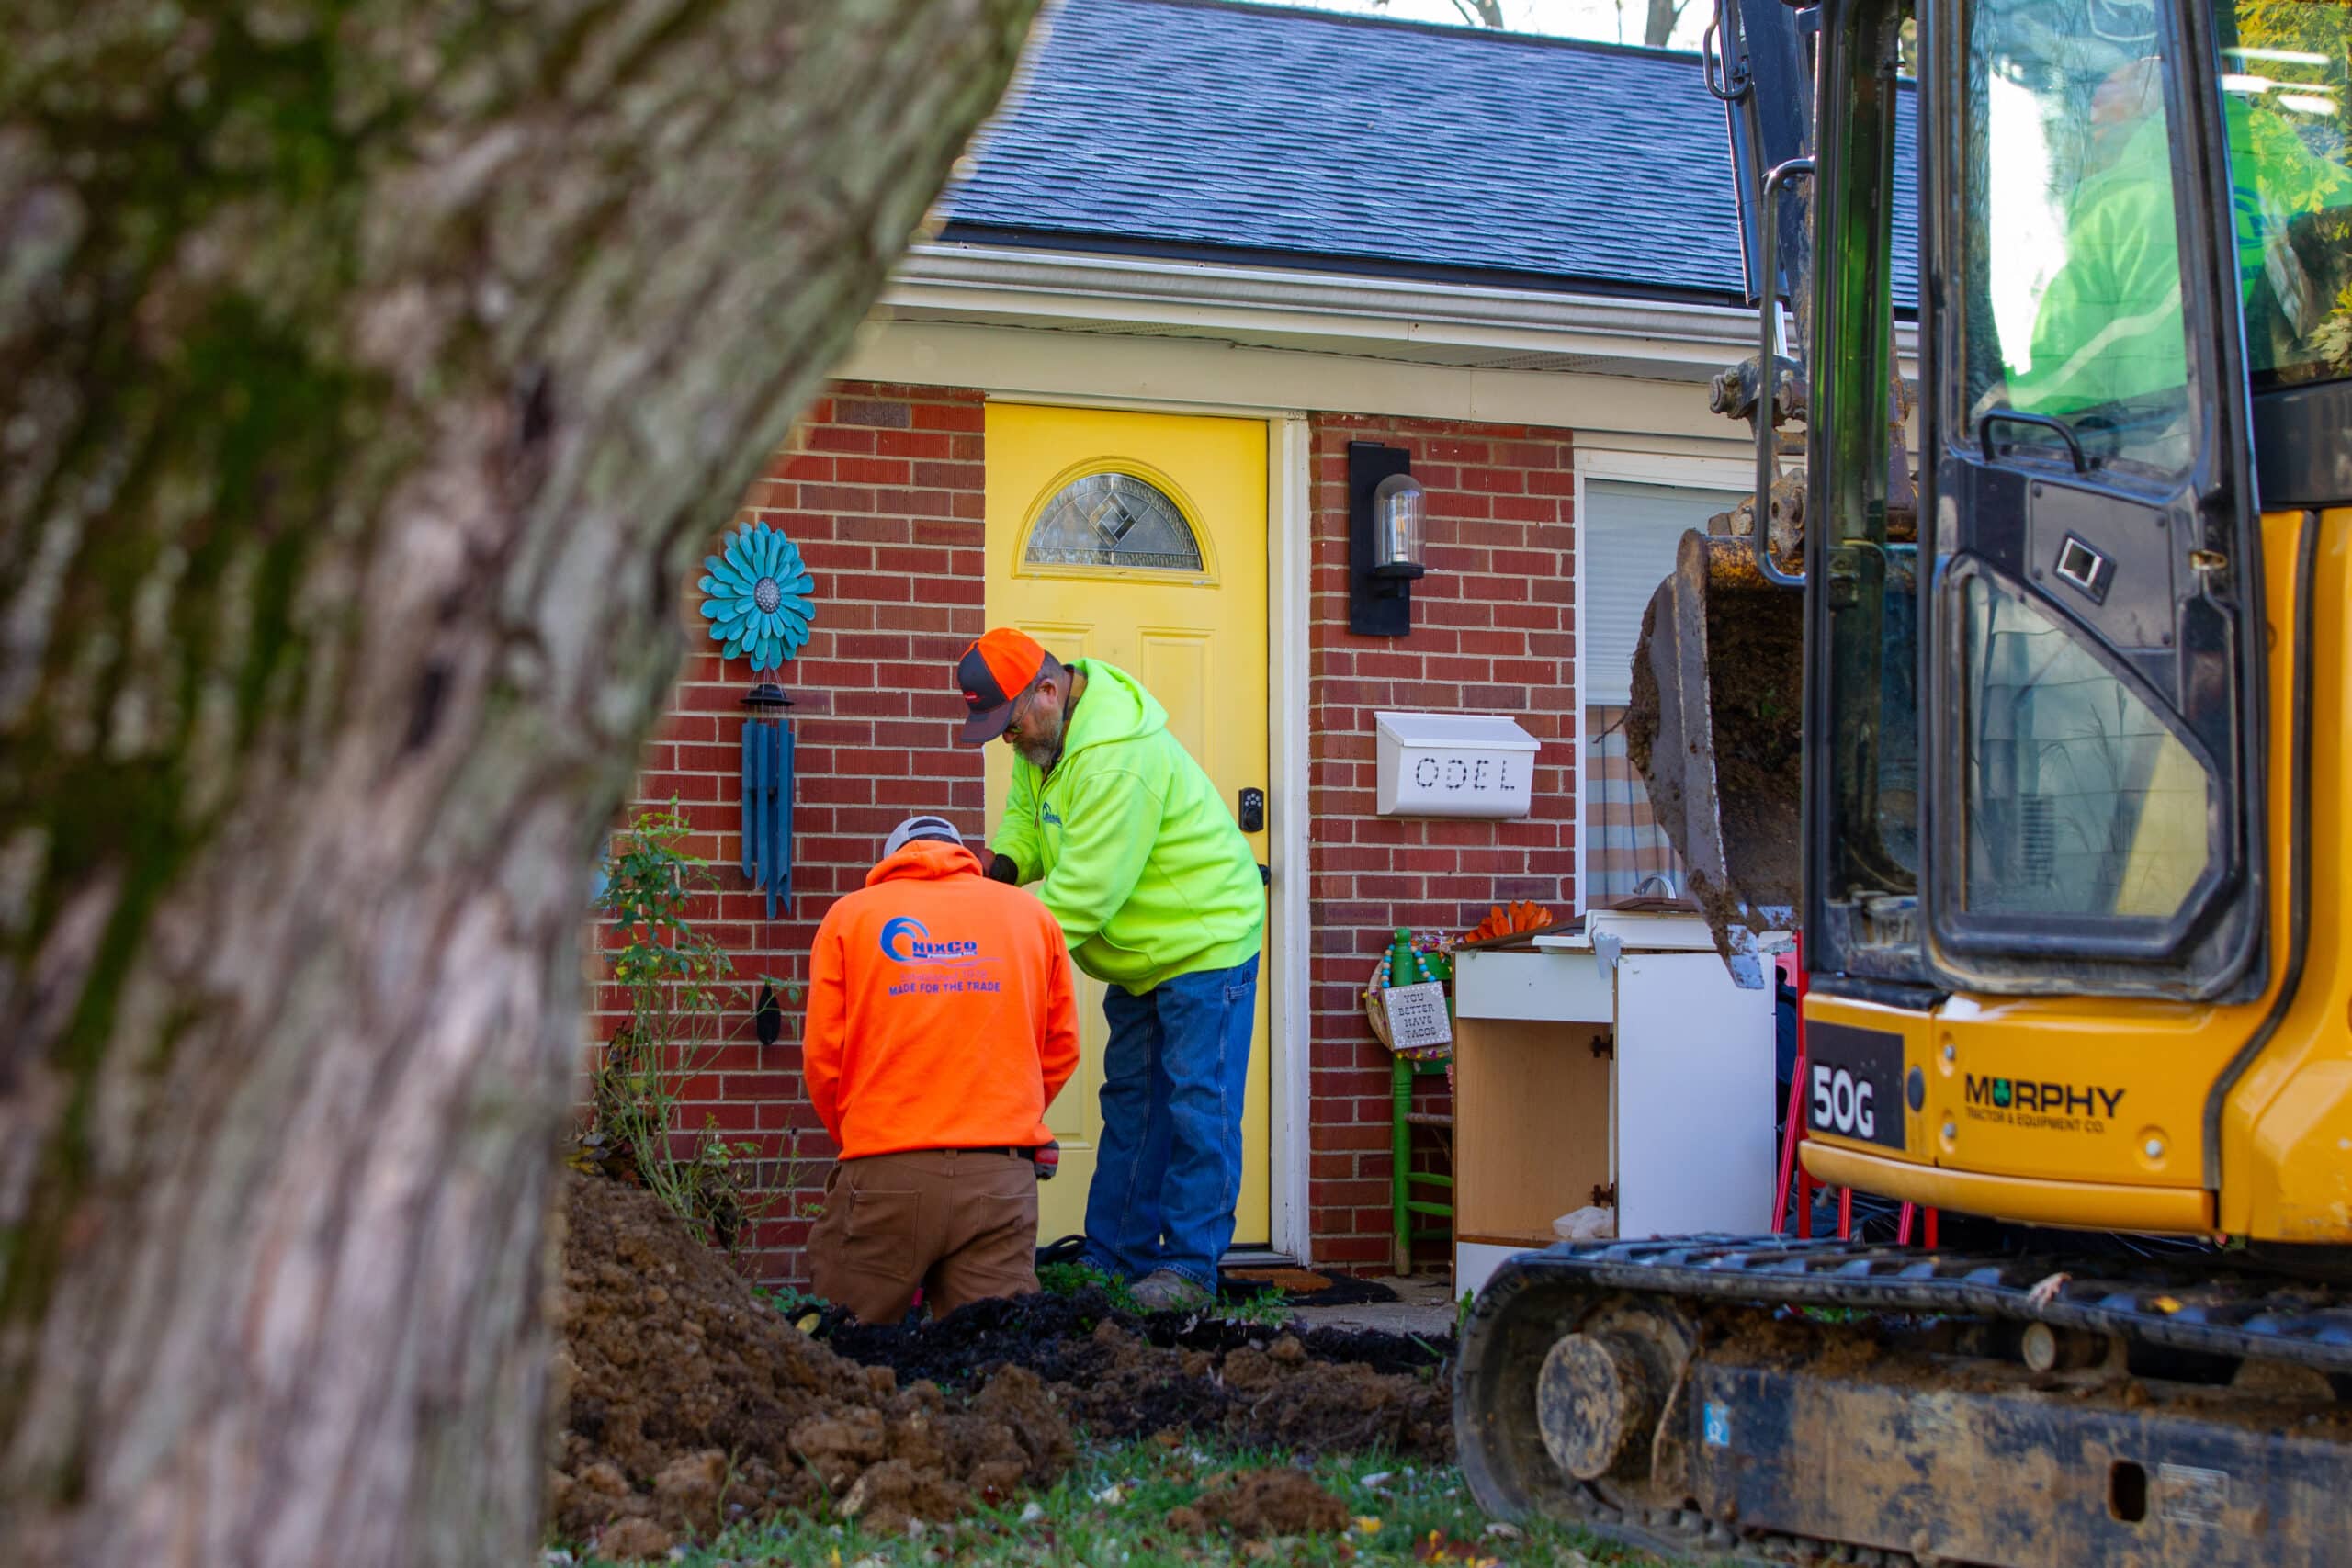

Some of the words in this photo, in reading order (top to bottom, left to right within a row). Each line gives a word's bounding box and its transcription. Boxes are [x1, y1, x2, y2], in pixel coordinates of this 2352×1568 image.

[1415, 758, 1515, 790] ODEL
[888, 982, 916, 996] MADE
[920, 982, 939, 993] FOR
[944, 981, 963, 992] THE
[967, 981, 1001, 992] TRADE
[1404, 993, 1424, 1003] YOU
[1397, 1004, 1435, 1016] BETTER
[1404, 1015, 1432, 1027] HAVE
[1405, 1027, 1437, 1038] TACOS
[1813, 1065, 1874, 1139] 50G
[1964, 1073, 2127, 1119] MURPHY
[1965, 1106, 2005, 1122] TRACTOR
[2007, 1113, 2013, 1124] &
[2018, 1114, 2081, 1132] EQUIPMENT
